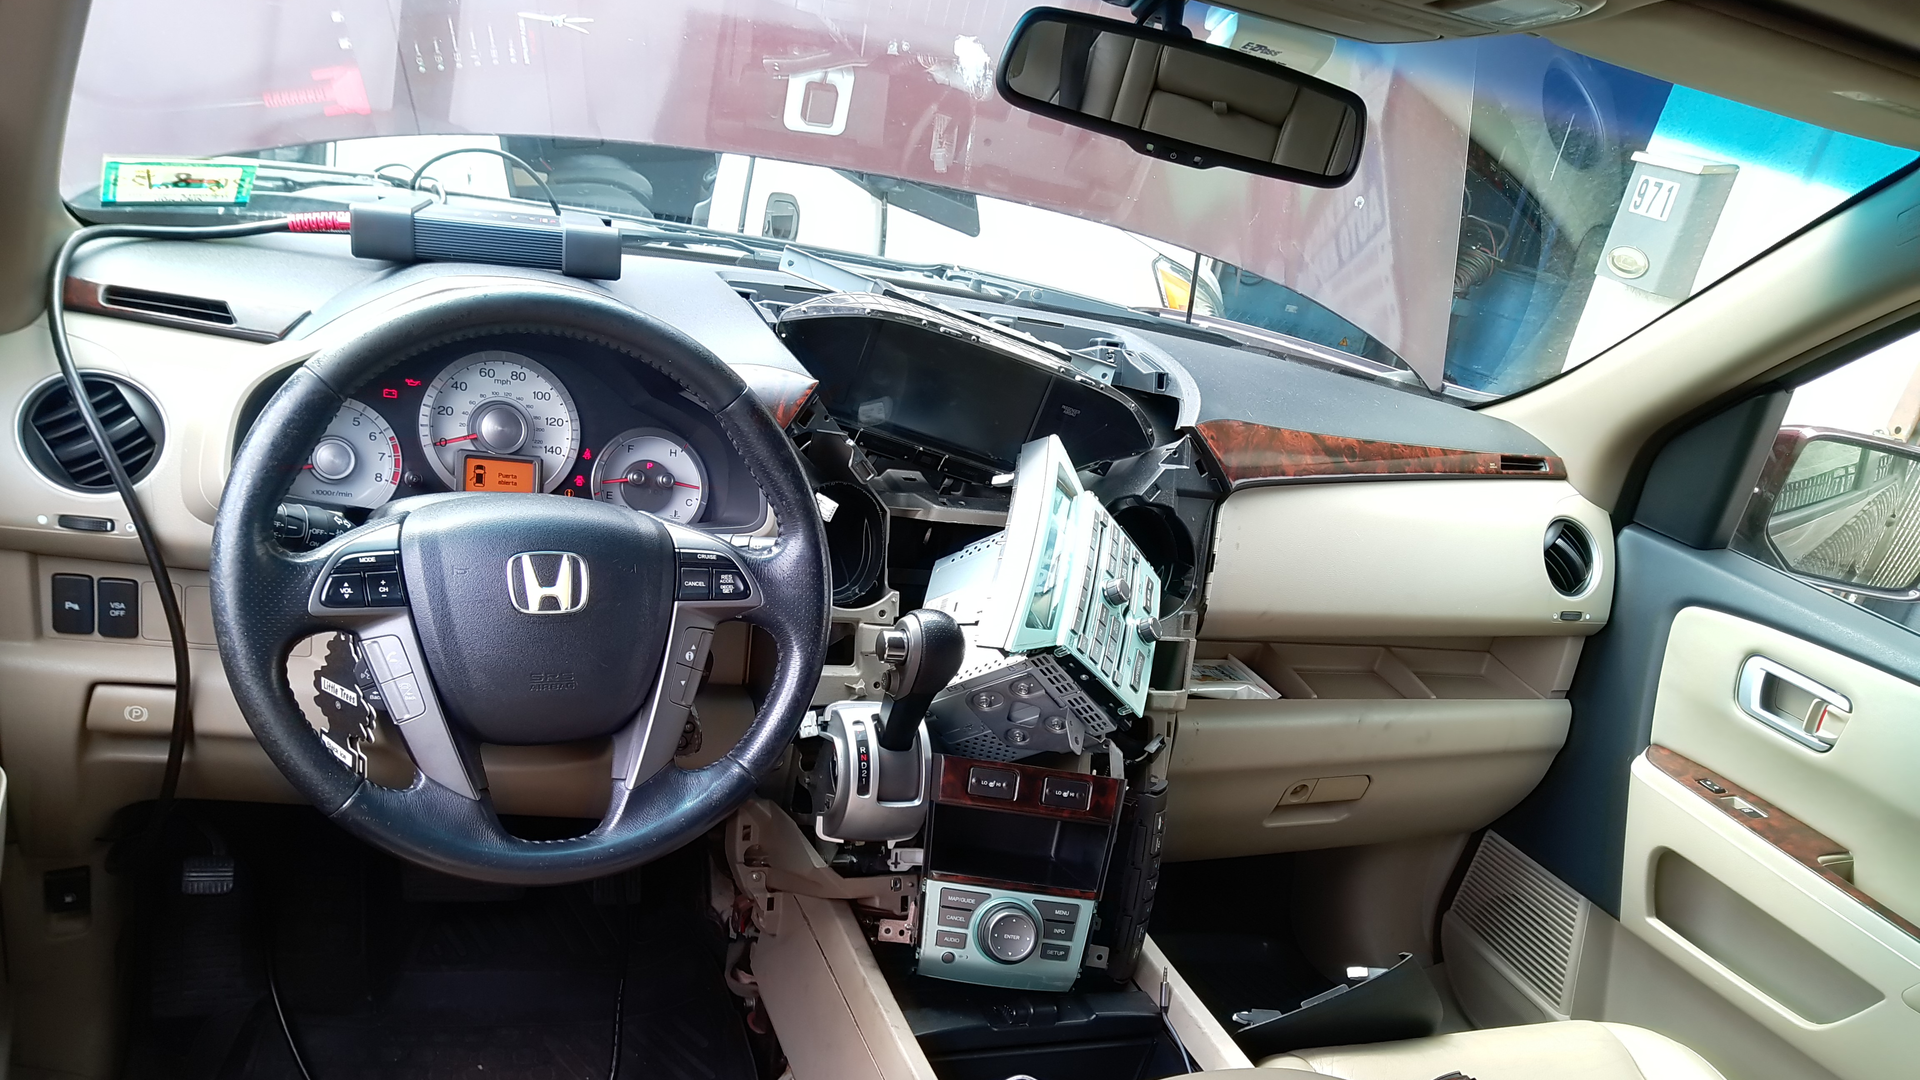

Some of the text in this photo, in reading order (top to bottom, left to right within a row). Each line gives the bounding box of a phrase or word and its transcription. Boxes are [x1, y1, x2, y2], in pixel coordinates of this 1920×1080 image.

[1634, 179, 1674, 218] 971
[480, 368, 496, 378] 60
[510, 371, 526, 381] 80
[451, 381, 468, 392] 40
[533, 391, 550, 401] 100
[438, 406, 454, 416] 20
[352, 417, 360, 426] 5
[546, 417, 564, 427] 120
[369, 432, 377, 441] 6
[544, 446, 562, 456] 140
[628, 445, 634, 453] F
[670, 449, 677, 457] H
[378, 452, 386, 461] 7
[374, 473, 382, 482] 8
[606, 491, 613, 499] E
[323, 679, 355, 704] Little Trees
[948, 896, 976, 904] MAP/GUIDE
